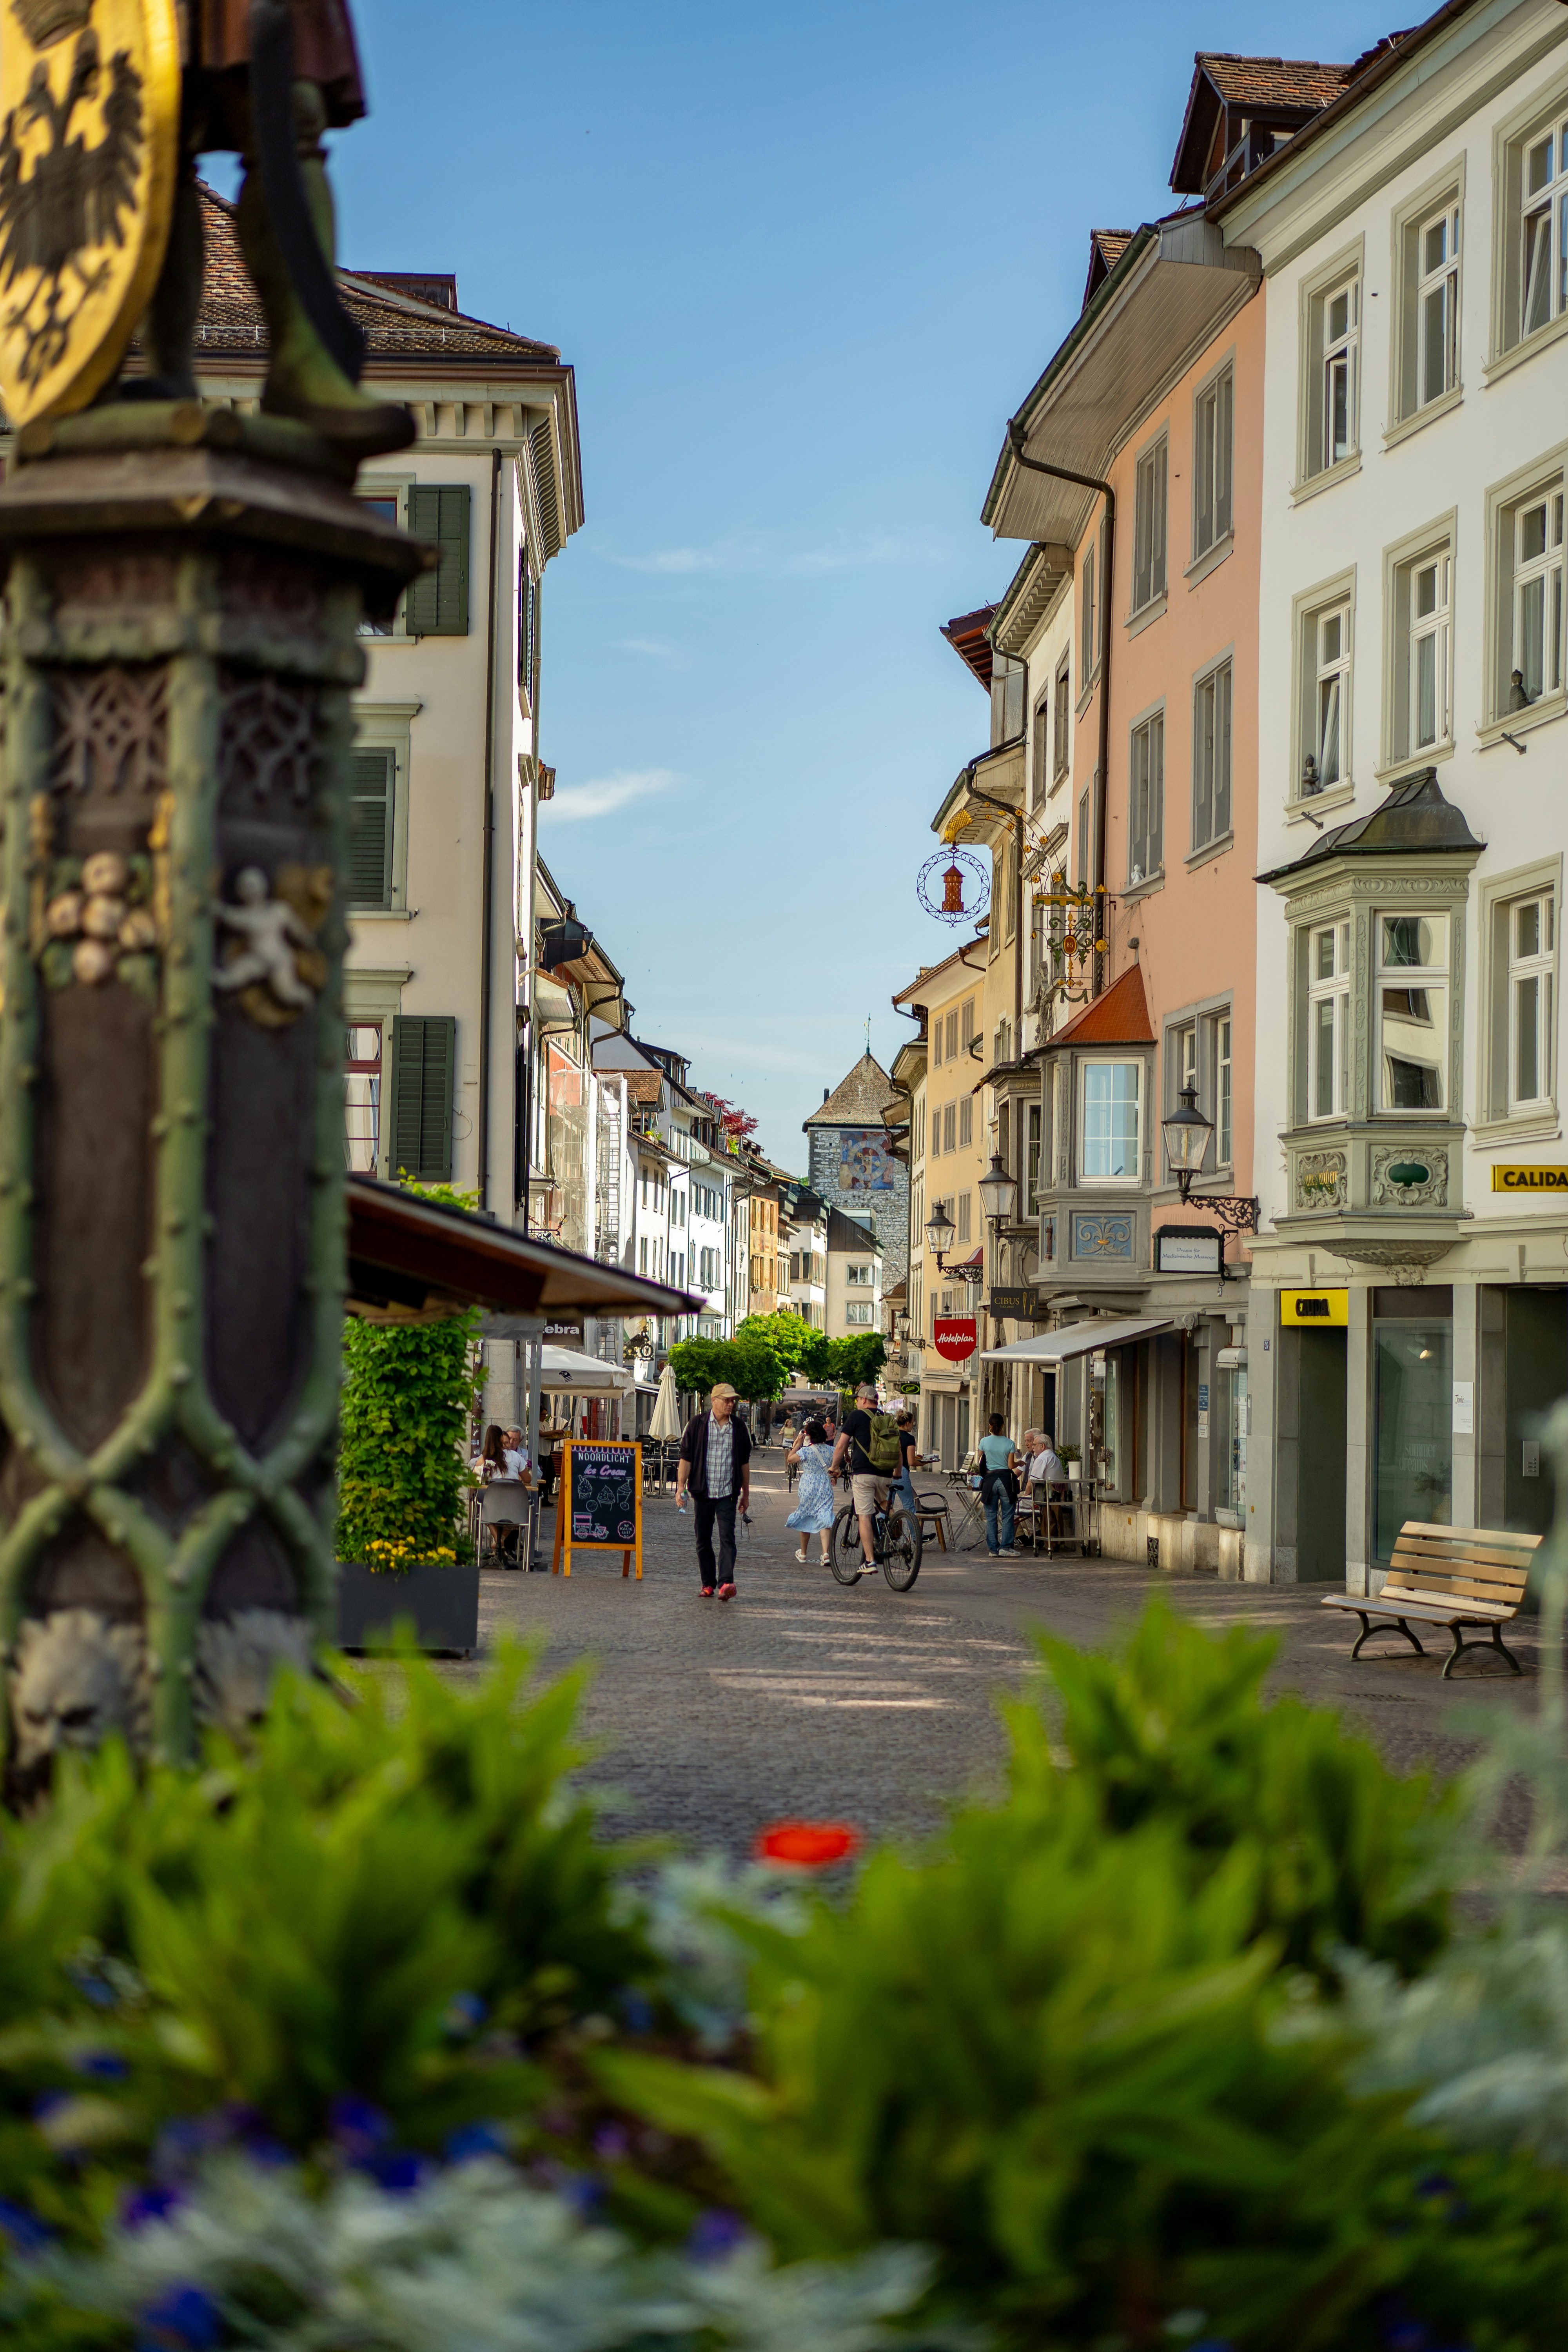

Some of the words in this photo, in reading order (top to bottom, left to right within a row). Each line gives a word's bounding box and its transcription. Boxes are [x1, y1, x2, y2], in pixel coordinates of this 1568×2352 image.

[1503, 1171, 1568, 1187] CALIDA
[543, 1324, 579, 1334] ebra
[937, 1332, 974, 1345] Hotelplan
[1405, 1443, 1437, 1457] summer
[578, 1452, 630, 1463] NOORDLICHT
[1399, 1453, 1428, 1472] dreams
[600, 1465, 626, 1475] Cream
